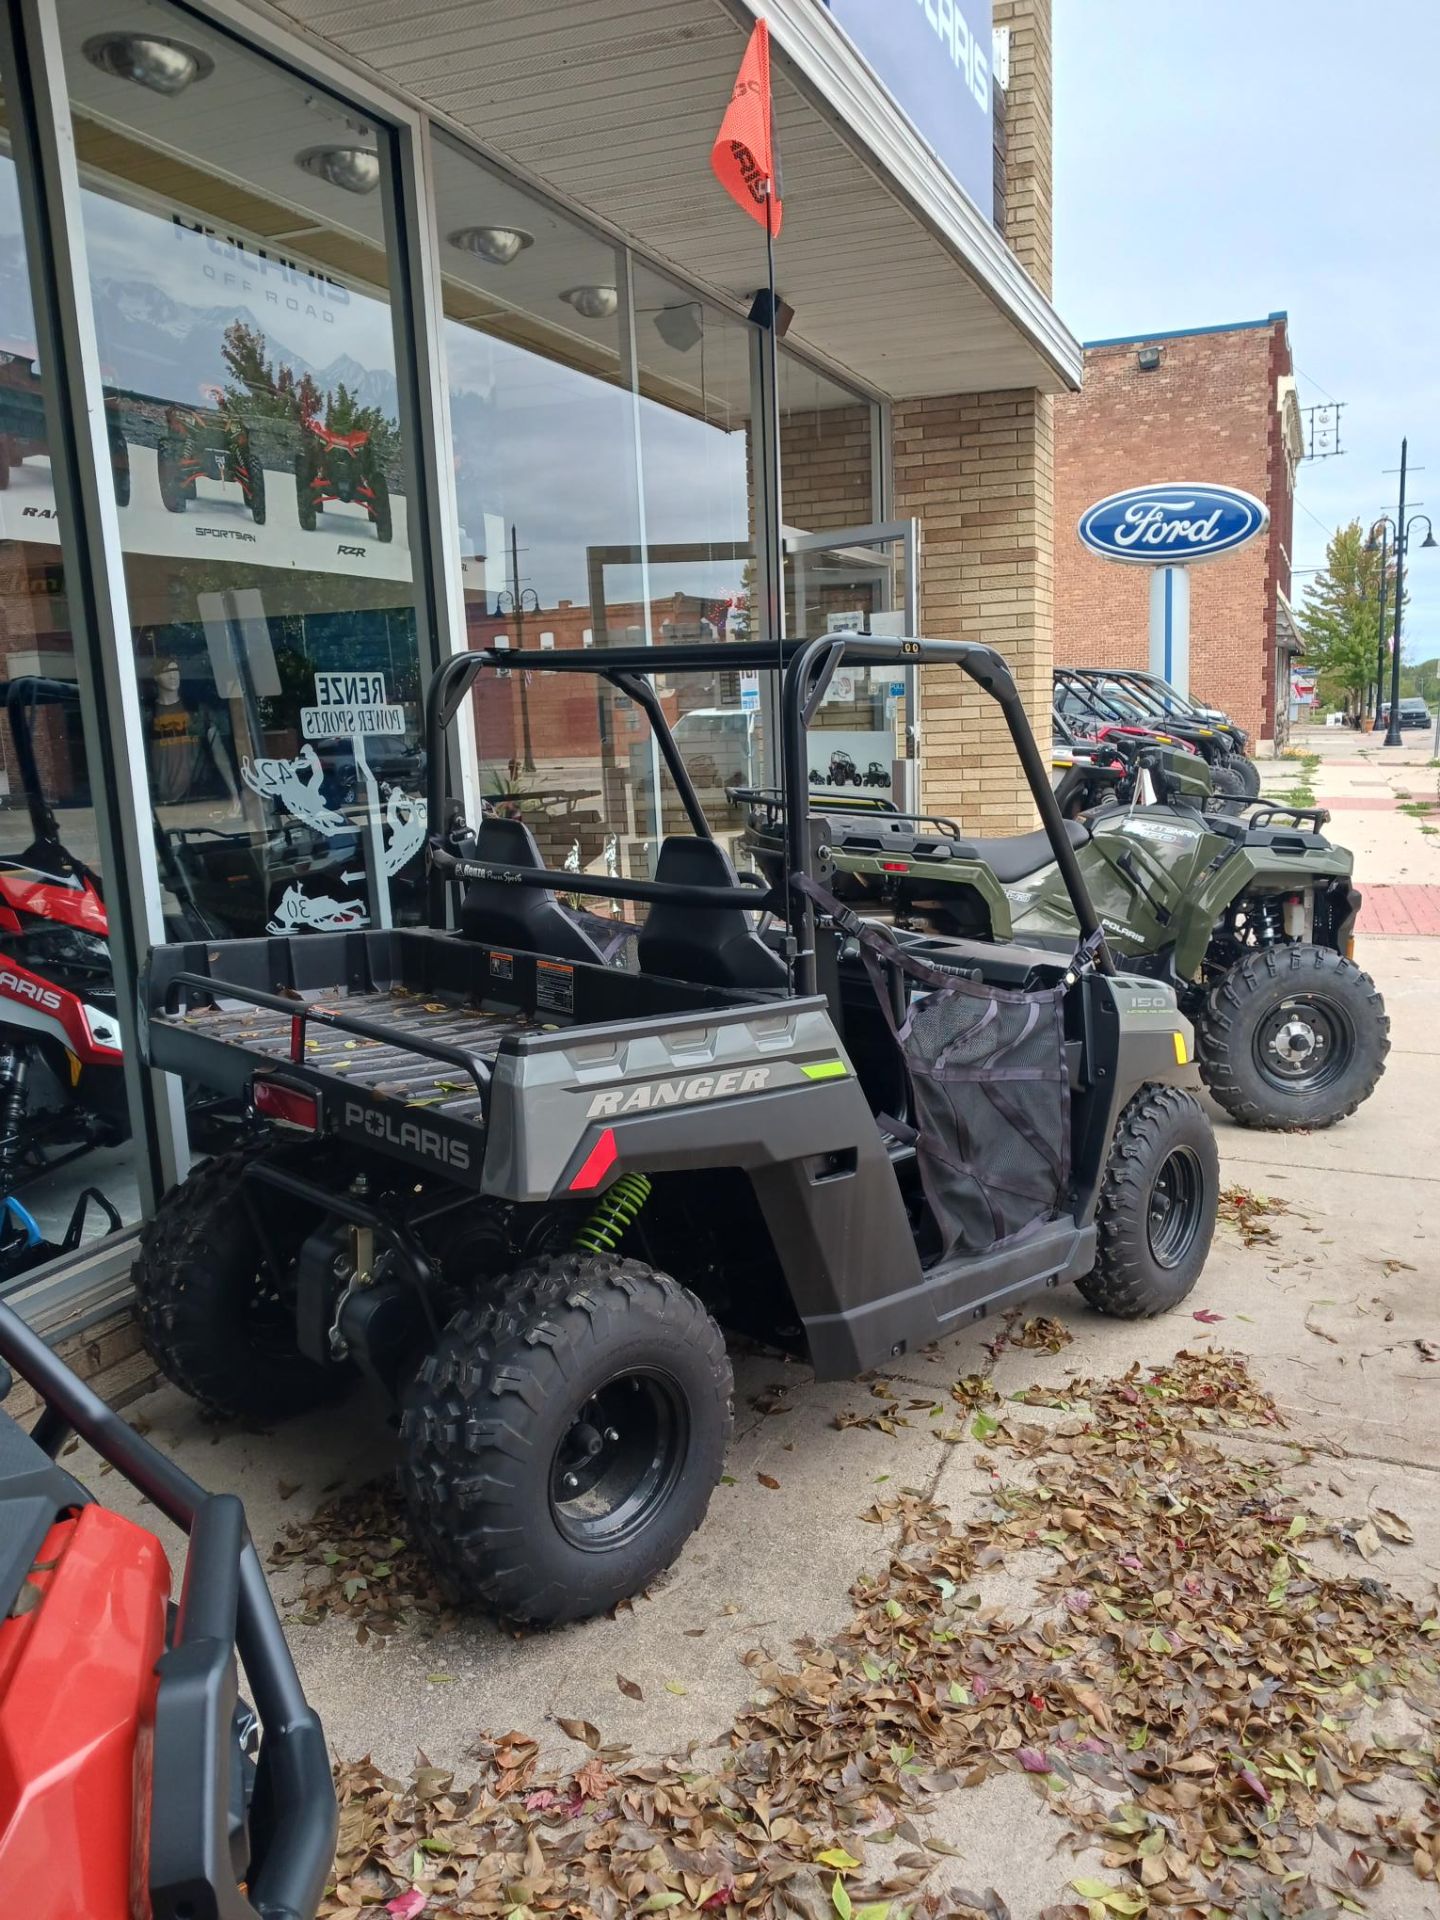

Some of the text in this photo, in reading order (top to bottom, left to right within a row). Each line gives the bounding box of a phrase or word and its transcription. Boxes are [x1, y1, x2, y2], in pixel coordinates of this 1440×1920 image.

[265, 290, 335, 324] ROAD
[1114, 501, 1224, 547] Ford
[336, 545, 367, 557] RZR
[1101, 918, 1145, 943] POLARIS
[1131, 997, 1166, 1007] 150
[585, 1067, 770, 1118] RANGER
[344, 1101, 470, 1170] POLARIS
